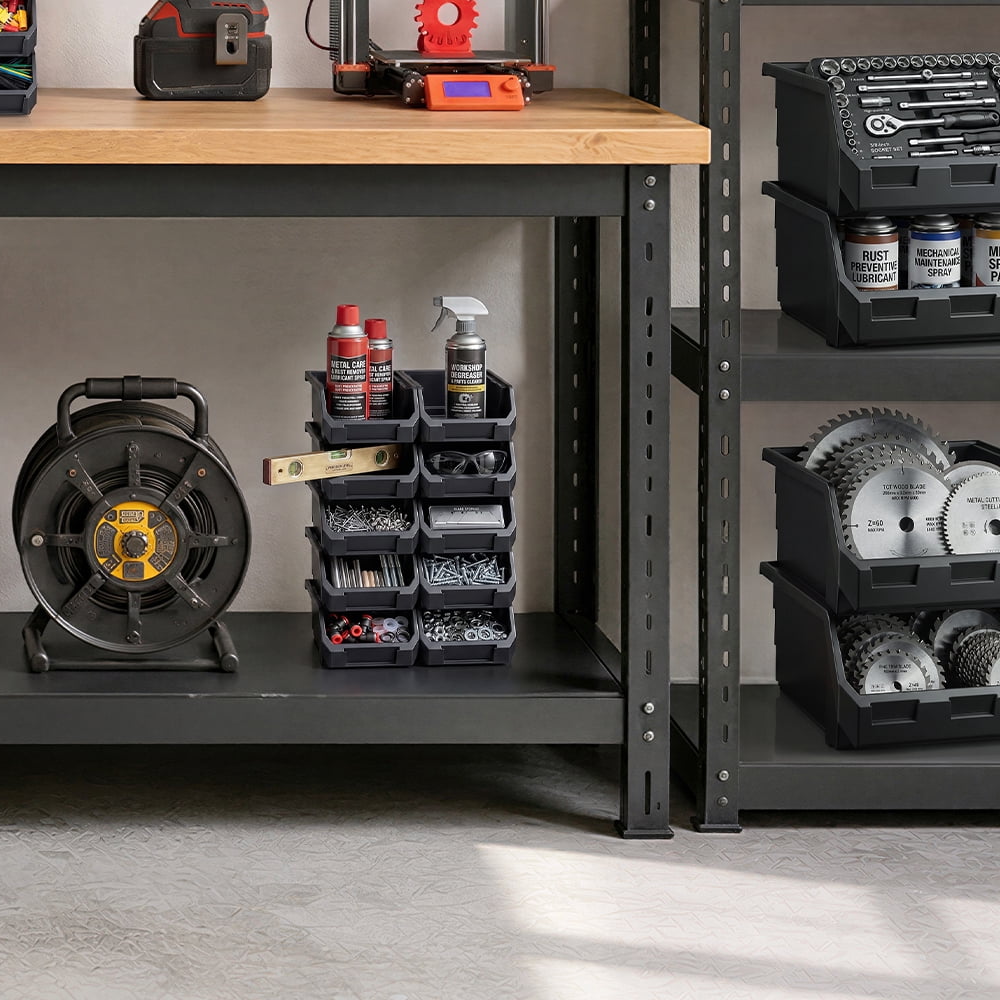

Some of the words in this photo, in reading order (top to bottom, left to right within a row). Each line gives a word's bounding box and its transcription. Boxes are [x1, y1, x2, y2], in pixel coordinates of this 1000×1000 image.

[862, 250, 889, 261] RUST
[916, 248, 960, 258] MECHANICAL
[989, 246, 1000, 256] M
[914, 256, 960, 266] MAINTENANCE
[850, 261, 898, 272] PREVENTIVE
[852, 272, 897, 282] LUBRICANT
[927, 268, 952, 278] SPRAY
[332, 360, 350, 368] METAL
